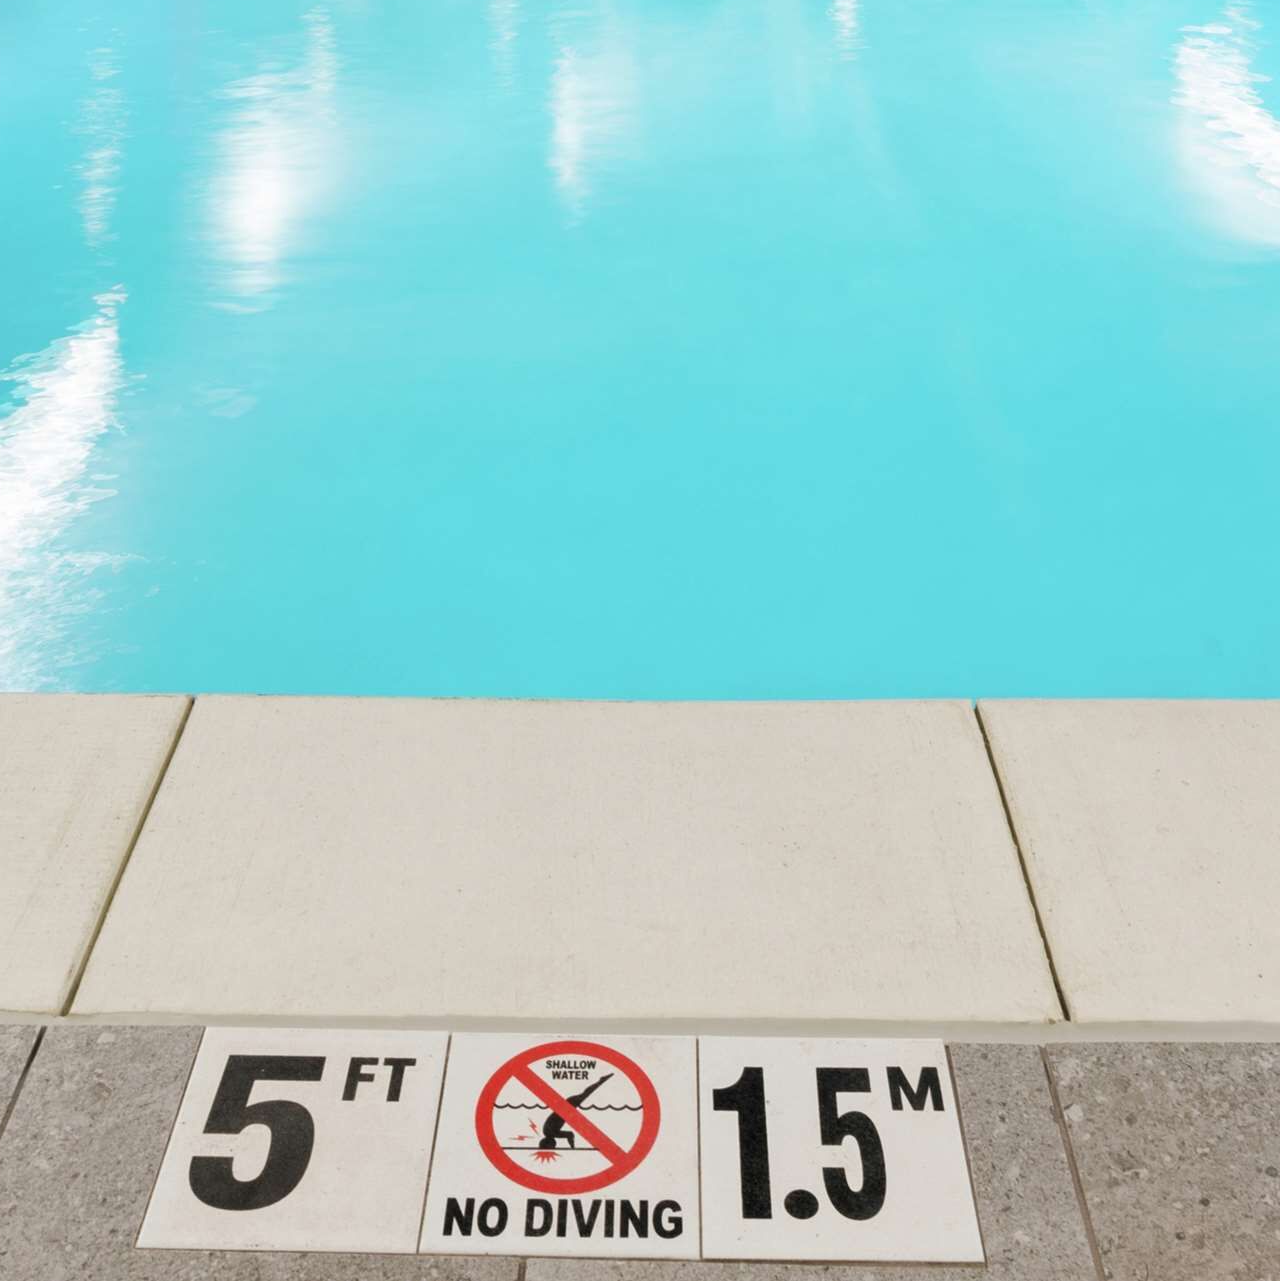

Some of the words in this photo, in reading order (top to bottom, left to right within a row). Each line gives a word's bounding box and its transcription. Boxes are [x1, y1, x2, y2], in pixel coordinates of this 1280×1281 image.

[545, 1060, 597, 1070] SHALLOW
[552, 1070, 589, 1080] WATER
[189, 1055, 326, 1211] 5
[342, 1057, 417, 1102] FT
[713, 1066, 887, 1221] 1.5
[886, 1066, 945, 1111] M
[443, 1197, 509, 1237] NO
[524, 1198, 683, 1239] DIVING
